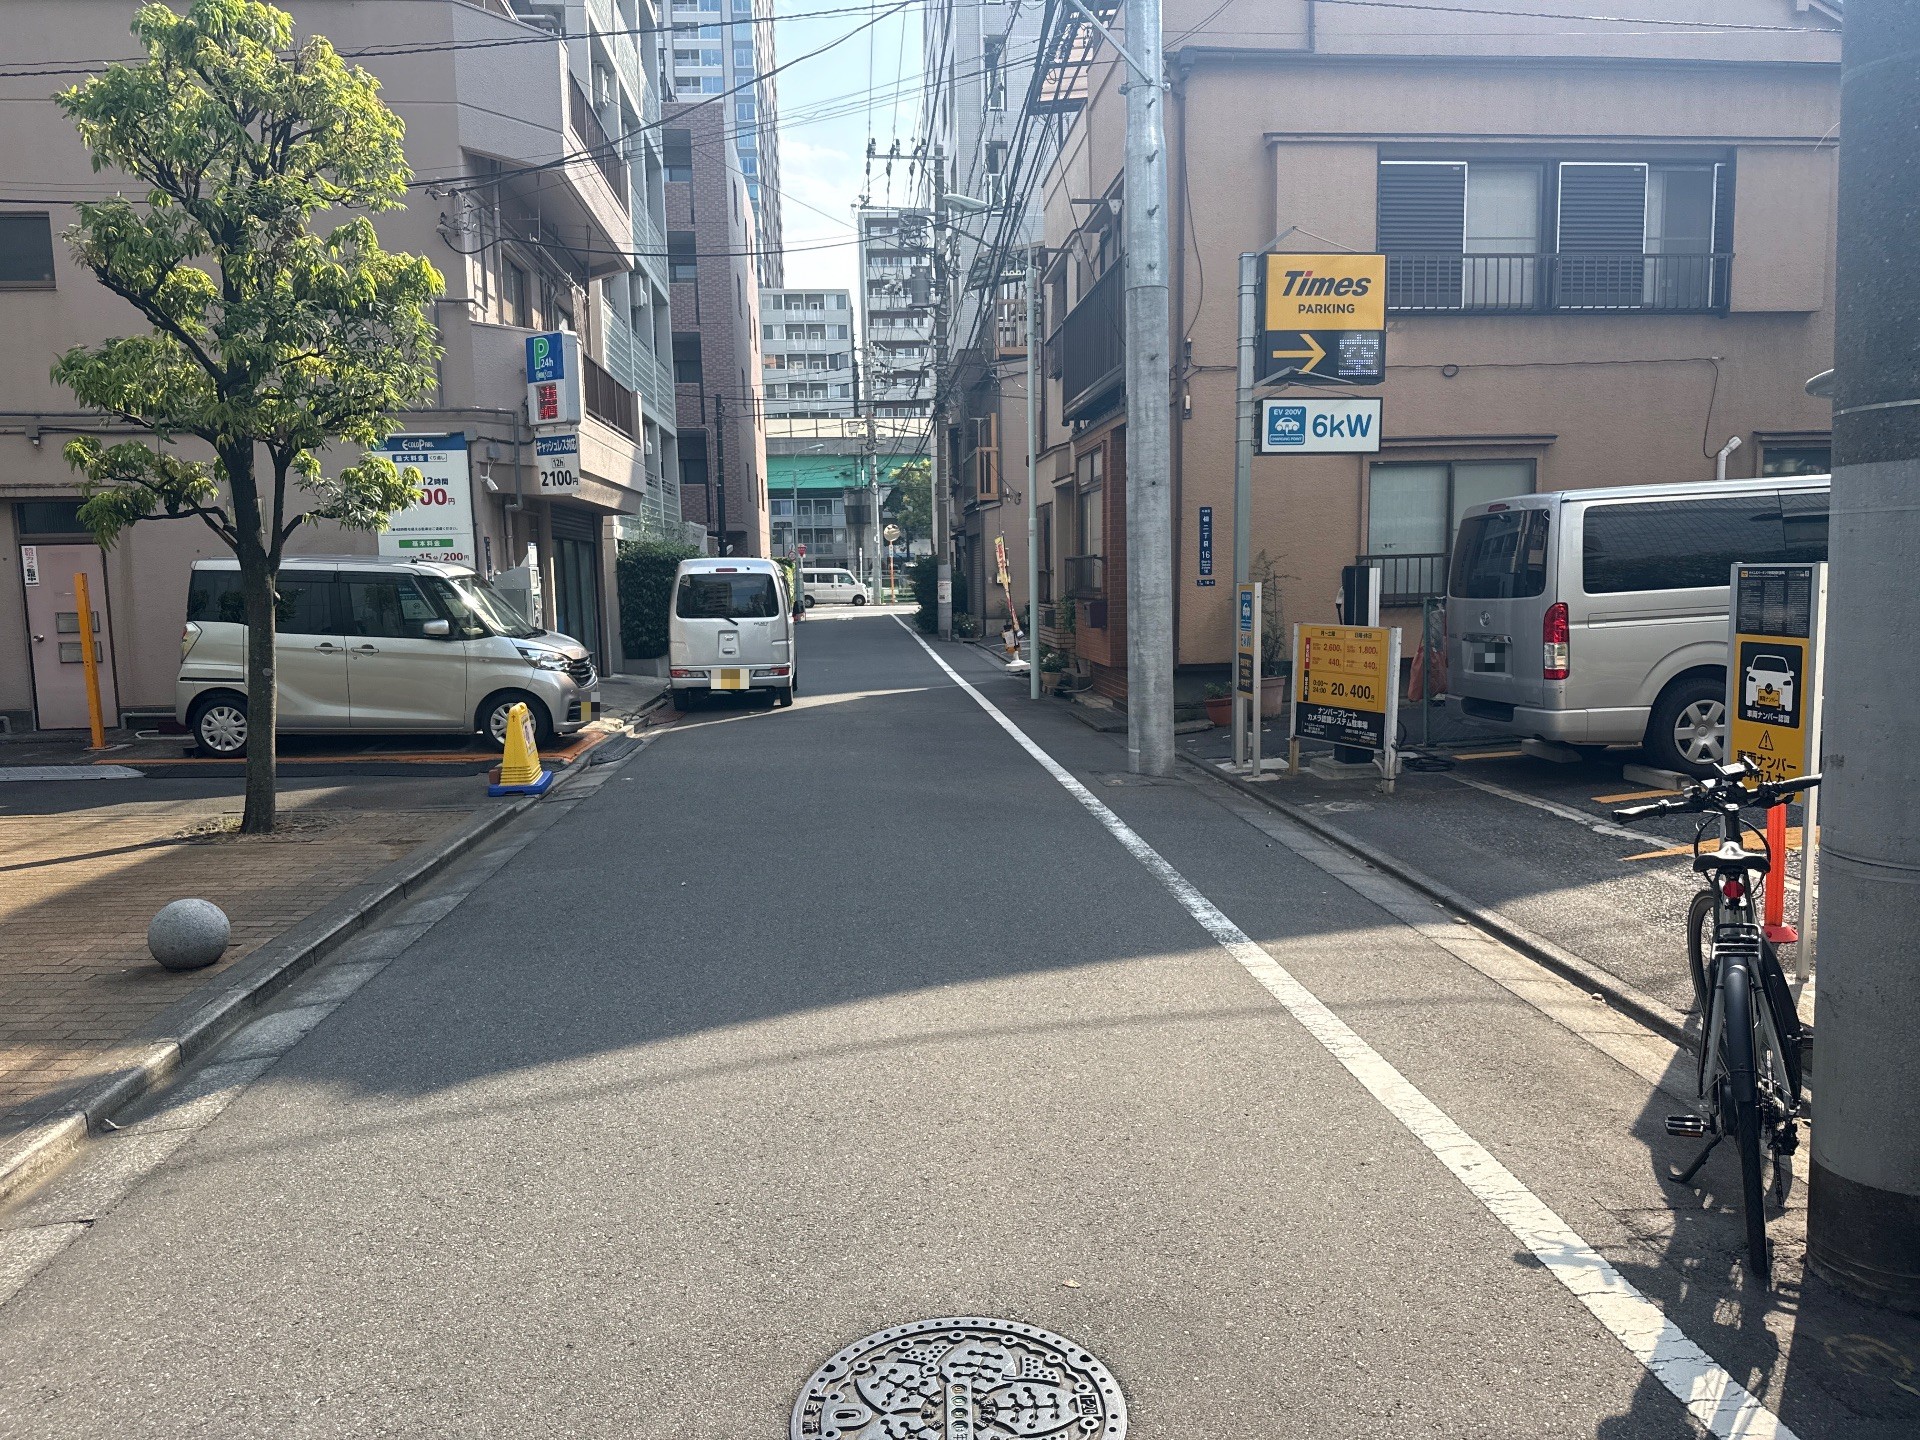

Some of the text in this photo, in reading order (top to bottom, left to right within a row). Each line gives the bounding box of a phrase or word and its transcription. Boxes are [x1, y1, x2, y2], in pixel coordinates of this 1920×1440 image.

[1282, 270, 1371, 297] Times
[1298, 303, 1355, 314] PARKING
[534, 338, 549, 369] P
[1339, 334, 1379, 376] 空
[541, 357, 554, 368] 24h
[1312, 413, 1372, 438] 6kW
[537, 438, 577, 453] キャッシュレス対応
[553, 459, 564, 467] 12h
[541, 470, 579, 486] 2100円
[1201, 551, 1210, 559] 16
[1312, 686, 1327, 694] 24:00
[1317, 707, 1358, 720] ナンバープレート
[1737, 749, 1797, 772] 車両ナンバー
